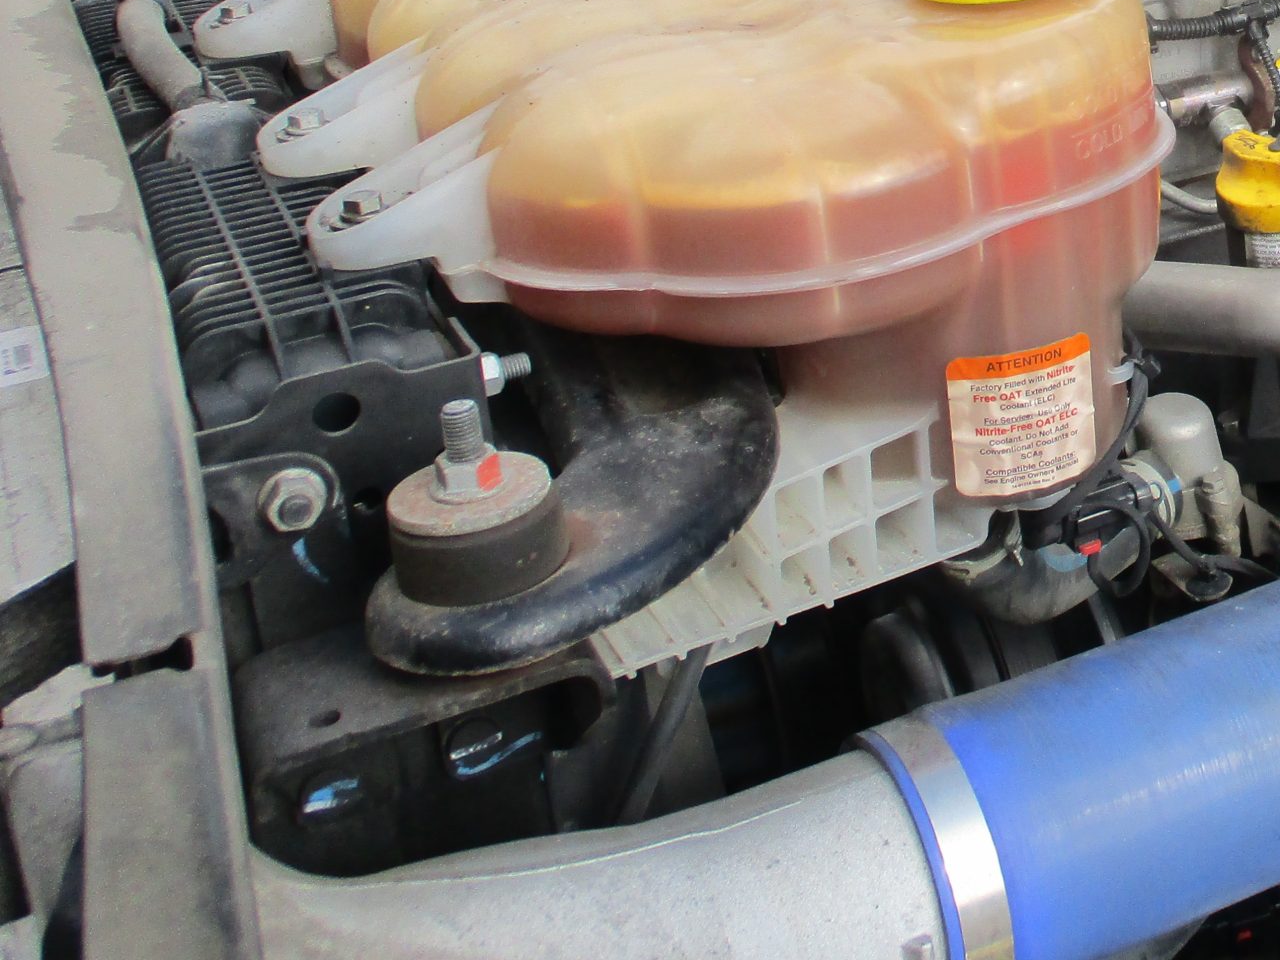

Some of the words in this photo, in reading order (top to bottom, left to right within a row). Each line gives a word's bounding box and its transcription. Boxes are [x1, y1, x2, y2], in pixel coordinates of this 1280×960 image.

[986, 348, 1062, 372] ATTENTION
[970, 383, 1002, 393] Factory
[1004, 379, 1026, 389] Filled
[1028, 375, 1045, 385] with
[973, 394, 997, 403] Free
[1000, 390, 1022, 402] OAT
[1025, 382, 1061, 397] Extended
[1062, 377, 1076, 387] Life
[1000, 401, 1033, 411] Coolant
[1034, 394, 1056, 407] (ELC)
[975, 423, 1033, 437] Nitrite-Free
[1035, 416, 1057, 428] OAT
[1058, 408, 1079, 421] ELC
[984, 417, 998, 427] For
[1037, 408, 1053, 417] Use
[1055, 402, 1071, 413] Only
[1025, 432, 1037, 441] Do
[1039, 427, 1053, 438] Not
[1055, 422, 1070, 432] Add
[979, 442, 1034, 456] Conventional
[1035, 433, 1069, 447] Coolants
[1020, 450, 1043, 461] SCAs
[984, 477, 999, 485] See
[1000, 473, 1026, 484] Engine
[1027, 467, 1055, 478] Owners
[1055, 459, 1079, 471] Manual
[986, 462, 1036, 477] Compatible
